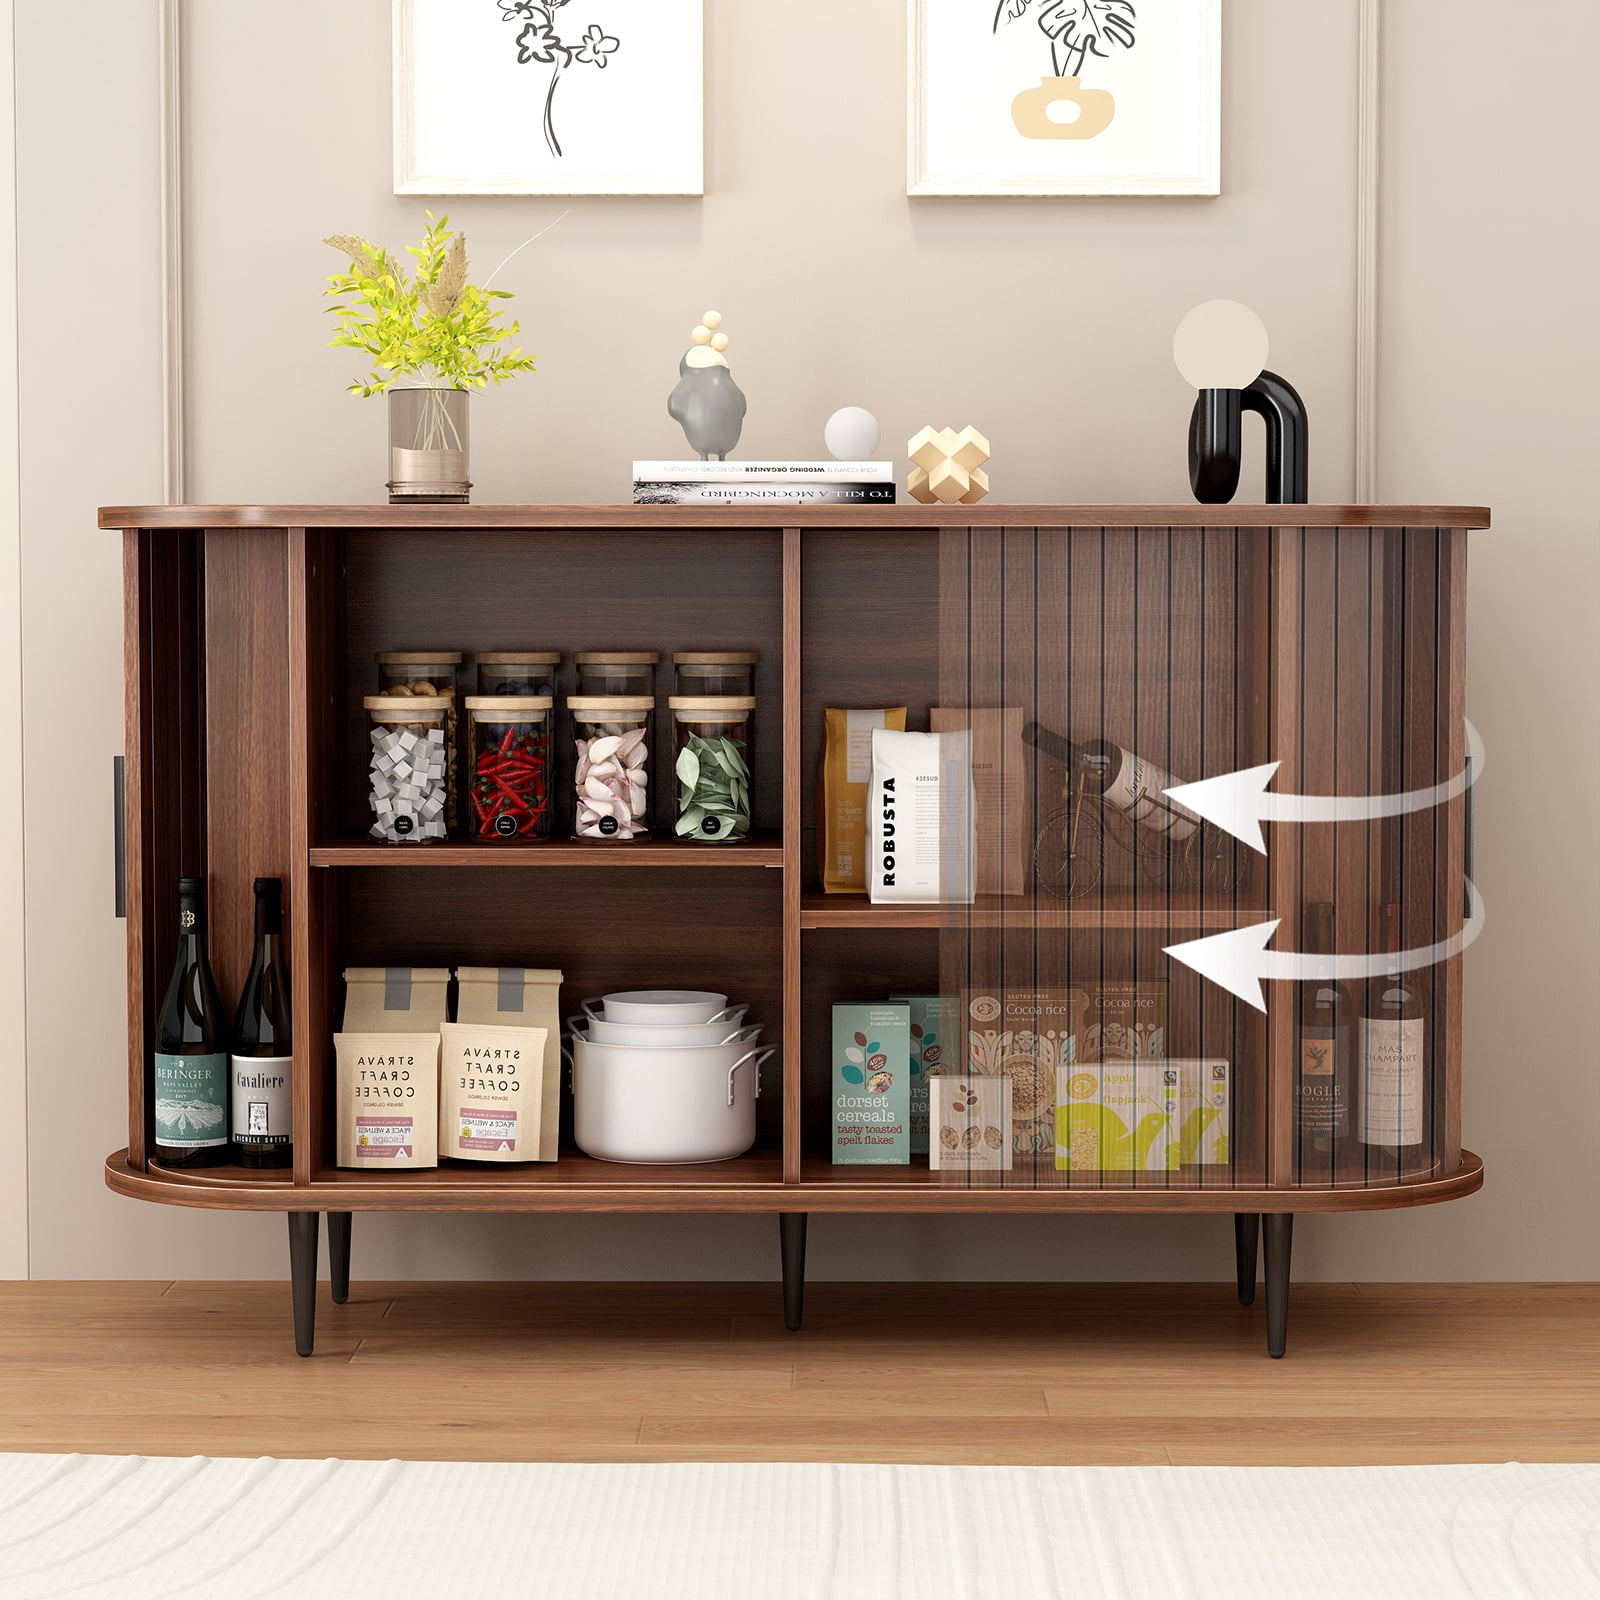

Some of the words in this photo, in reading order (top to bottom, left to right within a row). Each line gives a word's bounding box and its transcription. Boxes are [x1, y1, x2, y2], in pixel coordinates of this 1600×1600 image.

[701, 490, 814, 498] MOCKINGBIRD
[814, 490, 828, 498] A
[834, 490, 865, 498] KILL
[870, 490, 892, 498] TO
[883, 777, 896, 886] ROBUSTA
[1095, 996, 1130, 1008] Cocoa
[1132, 996, 1154, 1008] rice
[1006, 1003, 1042, 1015] Cocoa
[1045, 1003, 1067, 1015] rice
[1378, 1045, 1402, 1053] MAS
[157, 1067, 212, 1080] BERINGER
[1103, 1073, 1136, 1084] Apple
[237, 1071, 284, 1089] Cavaliere
[836, 1094, 889, 1108] dorset
[1103, 1095, 1147, 1105] flapjack
[836, 1109, 895, 1122] cereals
[837, 1125, 864, 1135] tasty
[865, 1125, 903, 1134] toasted
[837, 1136, 863, 1146] spelt
[864, 1136, 895, 1145] flakes
